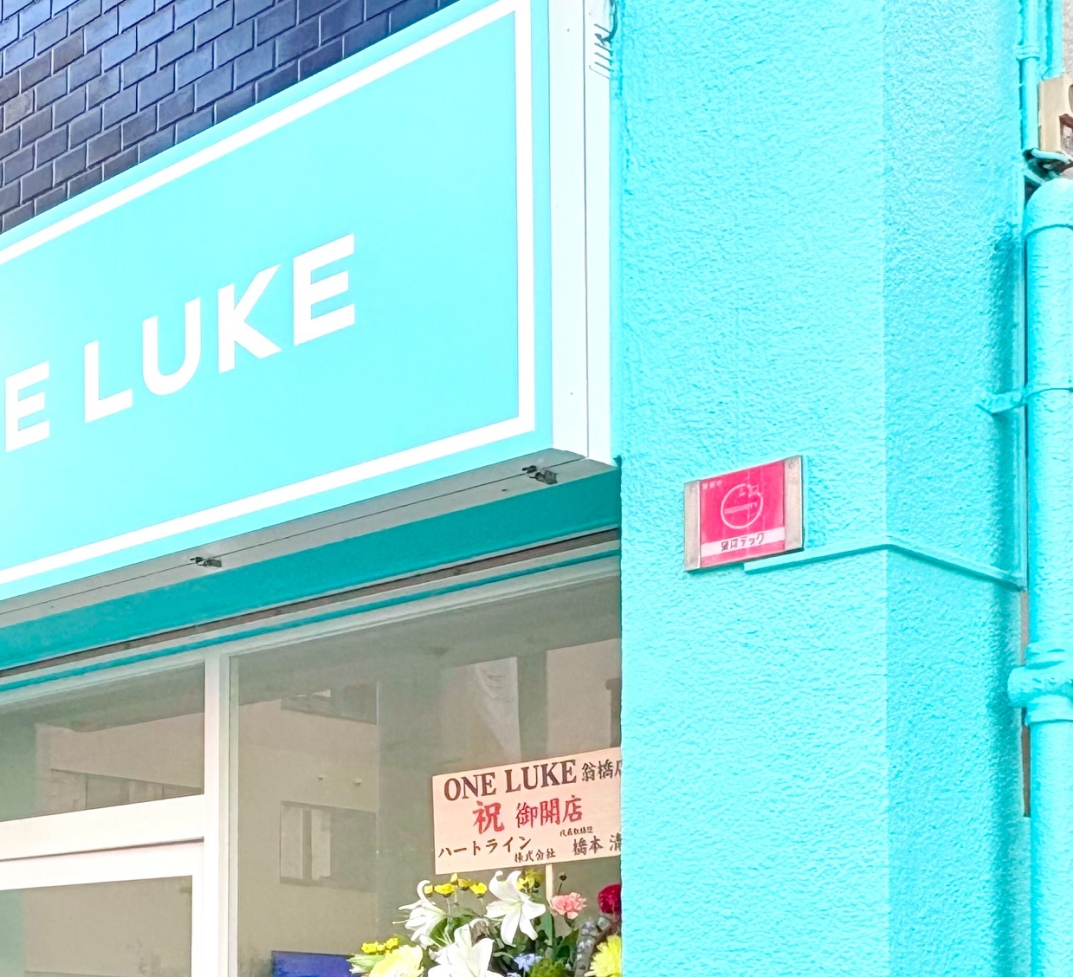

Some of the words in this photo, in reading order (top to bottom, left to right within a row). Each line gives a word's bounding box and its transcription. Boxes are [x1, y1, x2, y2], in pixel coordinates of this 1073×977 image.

[84, 233, 355, 423] LUKE
[443, 772, 497, 801] ONE
[505, 759, 577, 793] LUKE
[473, 801, 505, 834] 祝
[515, 795, 583, 829] 御開店
[438, 836, 532, 858] ハートライン
